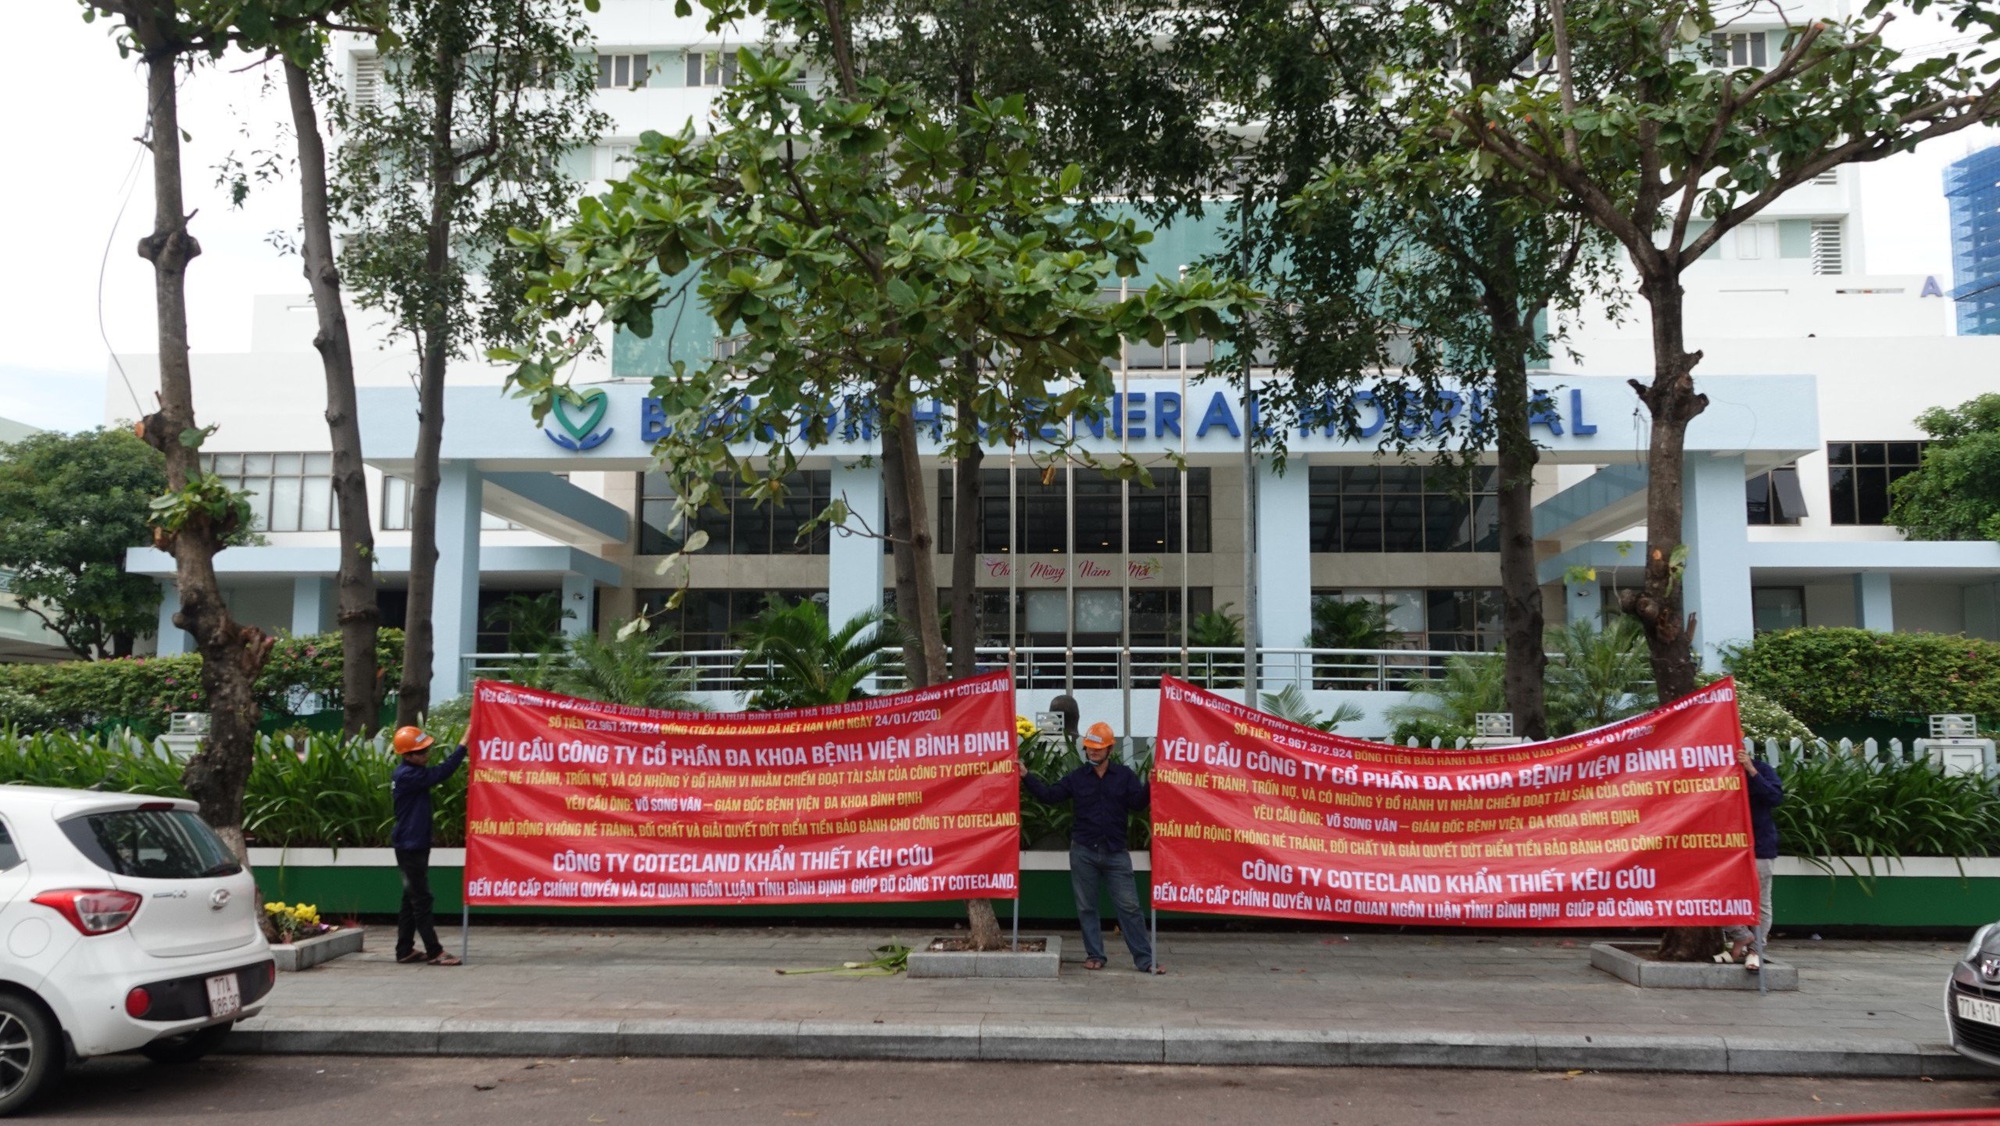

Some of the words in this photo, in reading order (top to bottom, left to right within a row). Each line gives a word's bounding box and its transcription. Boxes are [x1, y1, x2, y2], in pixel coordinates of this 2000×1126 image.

[1920, 275, 1943, 298] A
[1300, 388, 1598, 439] HOSPIAL
[479, 737, 514, 762] YÊU
[518, 736, 554, 763] CẦU
[558, 740, 609, 764] CÔNG
[614, 746, 638, 766] TY
[642, 741, 667, 766] CỔ
[671, 744, 721, 767] PHẦN
[726, 749, 752, 767] ĐA
[755, 747, 808, 767] KHOA
[812, 742, 863, 767] BỆNH
[867, 736, 910, 763] VIỆN
[916, 734, 960, 757] BÌNH
[964, 731, 1010, 756] ĐỊNH
[1162, 737, 1199, 763] YÊU
[1204, 741, 1242, 768] CẦU
[1246, 751, 1297, 778] CÔNG
[1302, 761, 1327, 782] TY
[1332, 764, 1359, 786] CỔ
[1363, 771, 1419, 790] PHẦN
[1423, 776, 1453, 791] ĐA
[1457, 772, 1513, 791] KHOA
[1519, 764, 1573, 789] BỆNH
[1578, 755, 1620, 780] VIỆN
[1625, 748, 1677, 773] BÌNH
[1681, 745, 1735, 772] ĐỊNH
[474, 769, 508, 783] KHÔNG
[509, 769, 523, 784] NÉ
[565, 769, 591, 786] TRỐN
[612, 771, 625, 787] VÀ
[628, 772, 642, 787] CÓ
[644, 773, 680, 788] NHỮNG
[683, 772, 690, 788] Ý
[708, 773, 736, 788] HÀNH
[739, 775, 749, 788] VI
[784, 770, 816, 787] CHIẾM
[818, 772, 845, 787] ĐOẠT
[847, 769, 862, 784] TÀI
[865, 766, 886, 783] SẢN
[888, 766, 908, 782] CỦA
[910, 765, 937, 781] CÔNG
[940, 765, 952, 778] TY
[565, 794, 585, 810] YÊU
[586, 795, 608, 811] CẦU
[635, 796, 649, 812] VÕ
[651, 799, 677, 812] SONG
[680, 797, 702, 812] VÂN
[714, 797, 741, 812] GIÁM
[743, 796, 764, 812] ĐỐC
[766, 796, 794, 813] BỆNH
[797, 795, 820, 812] VIỆN
[824, 797, 838, 810] ĐA
[841, 795, 868, 809] KHOA
[871, 792, 895, 807] BÌNH
[898, 792, 923, 807] ĐỊNH
[1154, 819, 1182, 837] PHẦN
[1184, 821, 1201, 839] MỞ
[1204, 825, 1232, 843] RỘNG
[1234, 829, 1269, 846] KHÔNG
[1272, 833, 1287, 848] NÉ
[1330, 838, 1348, 853] ĐỐI
[1350, 839, 1378, 856] CHẤT
[1381, 842, 1396, 857] VÀ
[1399, 840, 1421, 858] GIẢI
[1423, 841, 1458, 858] QUYẾT
[1461, 843, 1483, 858] DỨT
[1485, 839, 1514, 858] ĐIỂM
[1515, 840, 1542, 857] TIỀN
[1544, 838, 1567, 856] BẢO
[1570, 839, 1601, 855] BÀNH
[1605, 839, 1629, 853] CHO
[1632, 835, 1663, 851] CÔNG
[1665, 835, 1679, 849] TY
[553, 850, 601, 873] CÔNG
[606, 853, 630, 873] TY
[633, 853, 740, 873] COTECLAND
[744, 844, 795, 872] KHẨN
[801, 845, 852, 871] THIẾT
[856, 846, 892, 869] KÊU
[897, 844, 934, 867] CỨU
[469, 877, 492, 897] ĐẾN
[494, 878, 517, 897] CÁC
[519, 877, 541, 897] CẤP
[544, 879, 578, 897] CHÍNH
[581, 879, 619, 898] QUYỀN
[622, 880, 638, 898] VÀ
[640, 882, 655, 898] CƠ
[658, 882, 688, 898] QUAN
[692, 880, 723, 898] NGÔN
[725, 879, 755, 900] LUẬN
[758, 877, 784, 896] TỈNH
[788, 879, 815, 896] BÌNH
[818, 880, 846, 897] ĐỊNH
[852, 875, 877, 894] GIÚP
[880, 874, 895, 893] ĐỠ
[898, 873, 929, 892] CÔNG
[932, 876, 946, 891] TY
[1242, 859, 1293, 884] CÔNG
[1298, 866, 1322, 887] TY
[1327, 870, 1441, 893] COTECLAND
[1446, 867, 1503, 893] KHẨN
[1507, 868, 1566, 893] THIẾT
[1571, 868, 1611, 891] KÊU
[1616, 865, 1656, 889] CỨU
[1153, 882, 1177, 902] ĐẾN
[1180, 884, 1204, 903] CÁC
[1206, 885, 1230, 905] CẤP
[1232, 888, 1269, 908] CHÍNH
[1272, 891, 1312, 911] QUYỀN
[1316, 895, 1332, 912] VÀ
[1335, 899, 1352, 913] CƠ
[1354, 900, 1388, 916] QUAN
[1391, 901, 1425, 918] NGÔN
[1428, 901, 1461, 921] LUẬN
[1464, 899, 1493, 919] TỈNH
[1496, 901, 1527, 919] BÌNH
[1529, 903, 1560, 920] ĐỊNH
[1566, 898, 1595, 917] GIÚP
[1597, 898, 1615, 917] ĐỠ
[1618, 897, 1654, 916] CÔNG
[1655, 900, 1673, 916] TY
